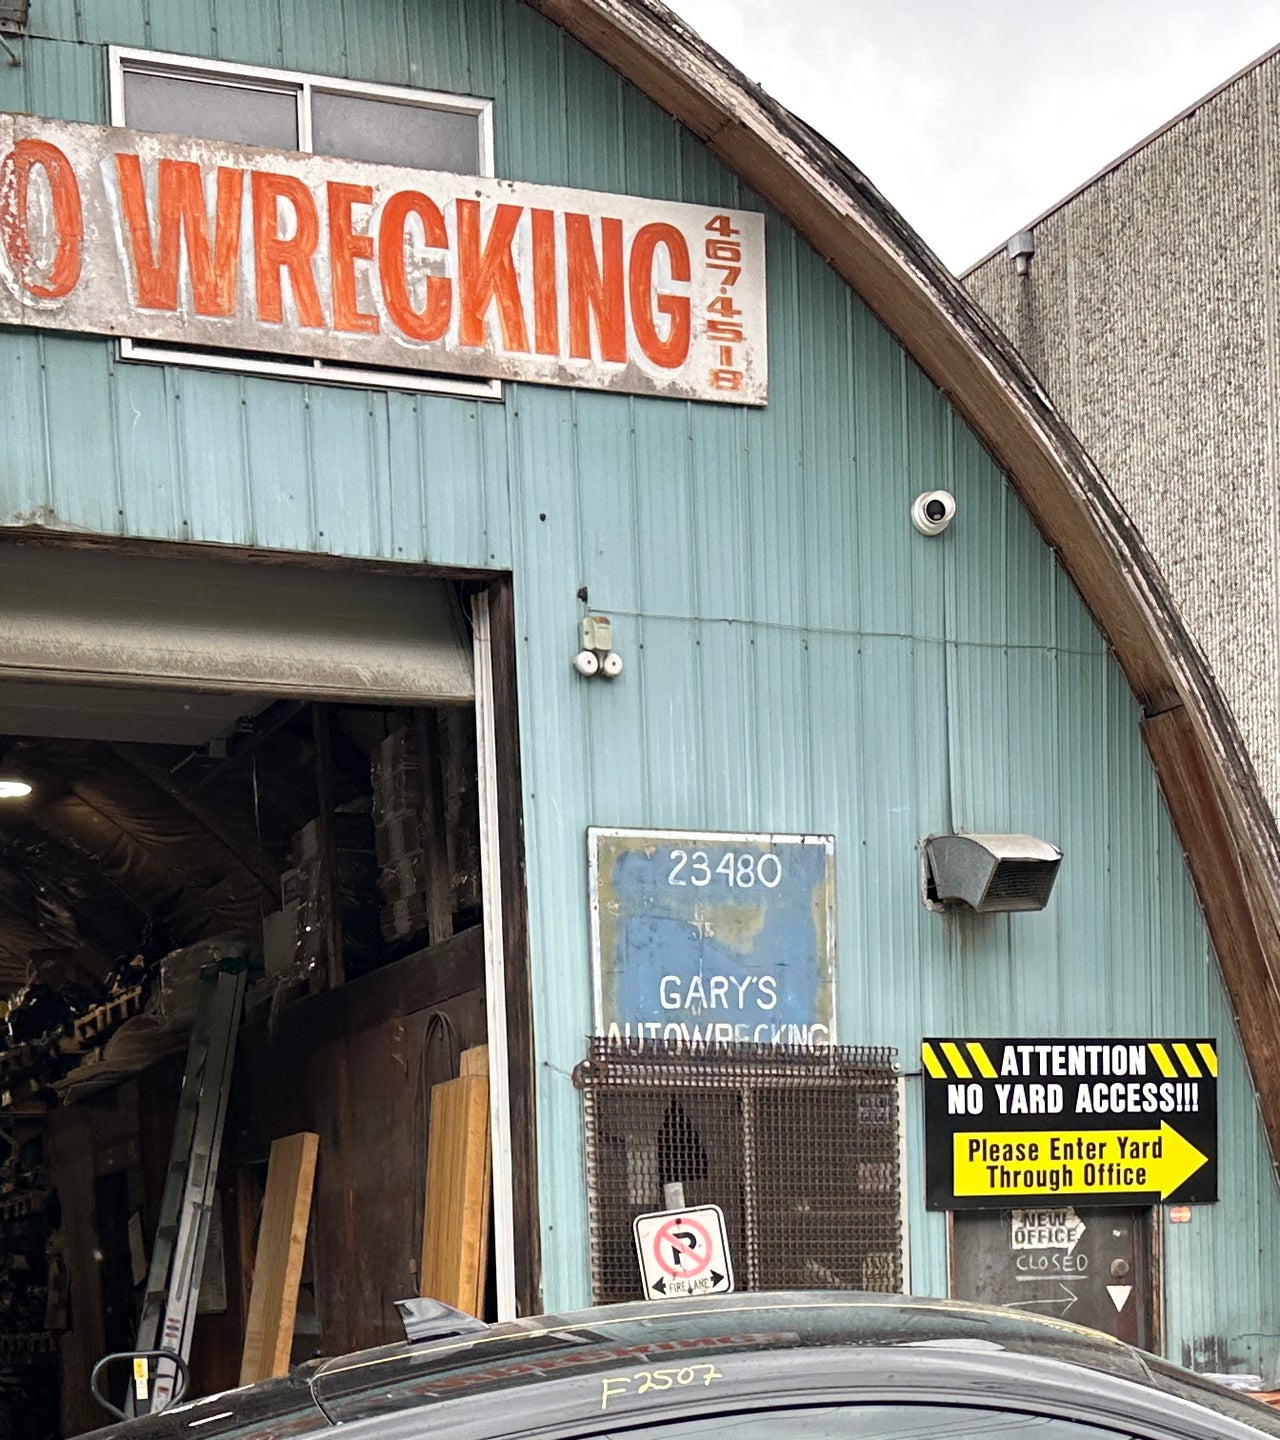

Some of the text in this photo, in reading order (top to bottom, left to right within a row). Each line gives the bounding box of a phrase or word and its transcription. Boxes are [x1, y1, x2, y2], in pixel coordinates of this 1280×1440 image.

[116, 152, 691, 368] WRECKING
[667, 849, 783, 888] 23480
[659, 975, 777, 1010] GARY'S
[1000, 1045, 1147, 1077] ATTENTION
[947, 1082, 1200, 1115] NO YARD ACCESS!!!
[968, 1135, 1163, 1163] Please Enter Yard
[986, 1163, 1147, 1191] Through Office
[1023, 1211, 1068, 1227] NEW
[1014, 1227, 1078, 1245] OFFICE
[1015, 1253, 1089, 1272] CLOSED
[669, 1278, 711, 1293] FIRE LANE
[601, 1364, 722, 1409] F2507
